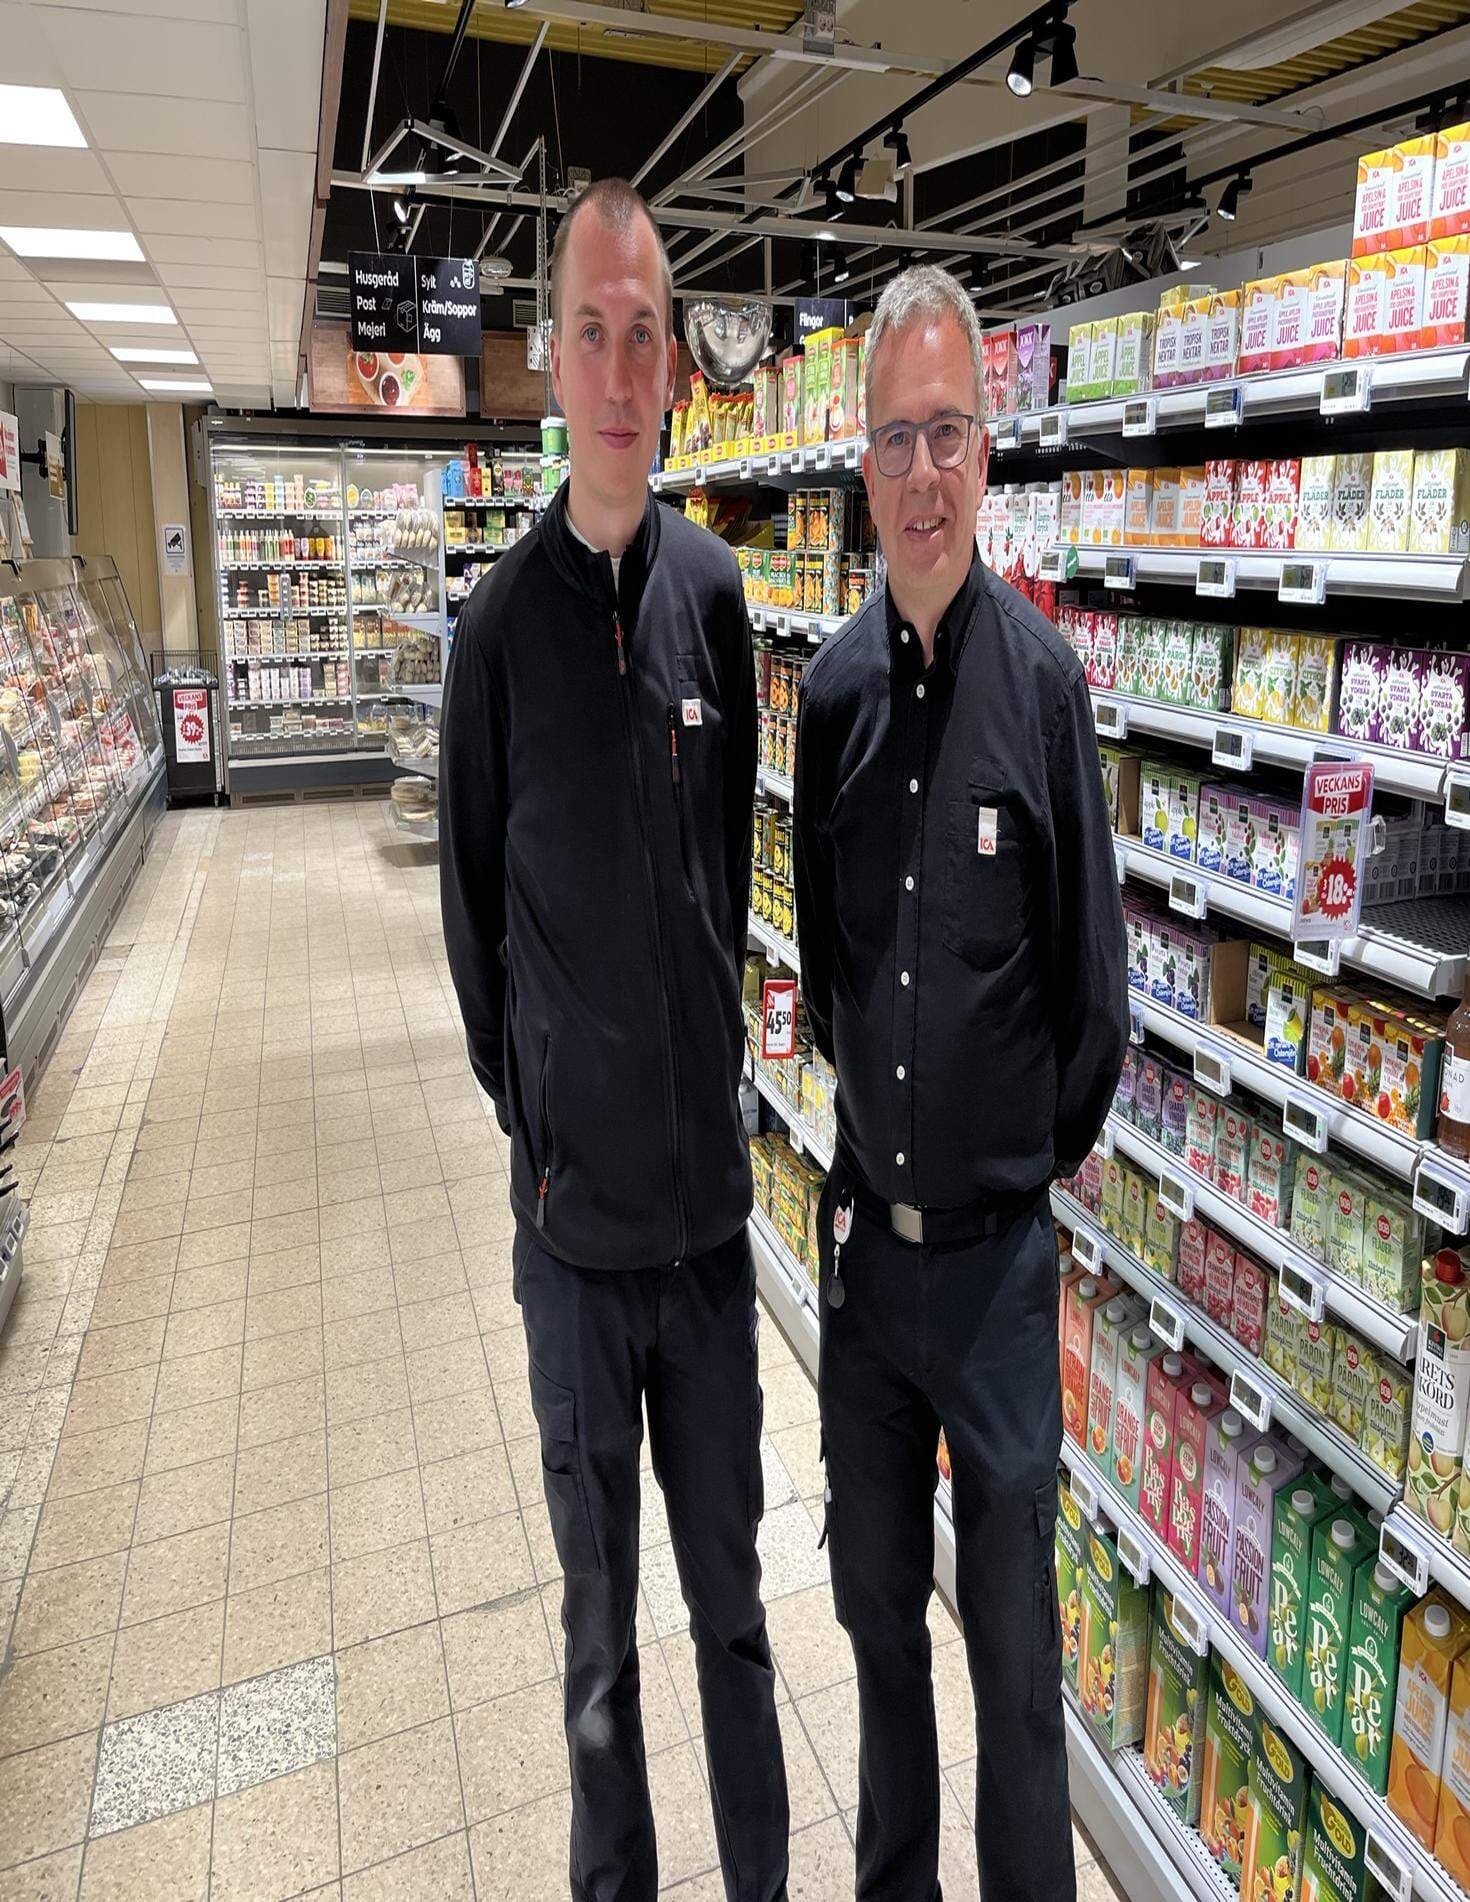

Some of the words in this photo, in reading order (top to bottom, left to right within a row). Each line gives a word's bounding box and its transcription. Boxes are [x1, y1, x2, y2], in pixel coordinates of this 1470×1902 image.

[1442, 166, 1464, 180] APELSIN
[1398, 179, 1419, 193] APELSIN
[1362, 189, 1382, 204] APELSIN
[1440, 185, 1466, 211] JUICE
[1360, 208, 1385, 231] JUICE
[1396, 198, 1422, 222] JUICE
[355, 270, 399, 288] Husgeråd
[421, 275, 436, 289] Sylt
[1432, 276, 1454, 290] APELSIN
[1355, 293, 1373, 305] APELSIN
[1390, 287, 1411, 300] APELSIN
[356, 296, 377, 311] Post
[422, 300, 477, 318] Kräm/Soppor
[1429, 297, 1458, 320] JUICE
[800, 313, 823, 328] Flingor
[1311, 317, 1335, 337] JUICE
[1353, 312, 1377, 334] JUICE
[1389, 306, 1414, 329] JUICE
[358, 322, 386, 339] Mejeri
[423, 323, 441, 342] Ägg
[1184, 333, 1202, 347] TROPISK
[1212, 326, 1229, 340] TROPISK
[1245, 330, 1266, 350] JUICE
[1277, 325, 1299, 344] JUICE
[1160, 337, 1176, 349] TROPISK
[1210, 339, 1228, 354] NEKTAR
[1159, 349, 1176, 363] NEKTAR
[1183, 346, 1201, 360] NEKTAR
[1351, 678, 1370, 686] SVARTA
[1390, 685, 1410, 693] SVARTA
[1431, 691, 1453, 699] SVARTA
[686, 708, 698, 720] ICA
[1316, 772, 1361, 795] VECKANS
[1324, 797, 1347, 814] PRIS
[980, 837, 994, 851] ICA
[766, 1010, 782, 1035] 45
[1092, 1372, 1113, 1399] ORANGE
[1117, 1400, 1139, 1431] ORANGE
[1205, 1493, 1229, 1533] PASSION
[1202, 1523, 1228, 1565] FRUIT
[1236, 1530, 1264, 1571] PASSION
[1234, 1559, 1263, 1604] FRUIT
[1158, 1626, 1193, 1676] Multivitamin
[1159, 1641, 1191, 1686] Fruchtdrink
[1217, 1709, 1251, 1757] Fruktdryck
[1256, 1755, 1295, 1815] Multivitamin
[1256, 1773, 1292, 1827] Fruchtdrink
[1314, 1828, 1357, 1893] Multivitamin
[1314, 1847, 1354, 1902] Fruchtdrink
